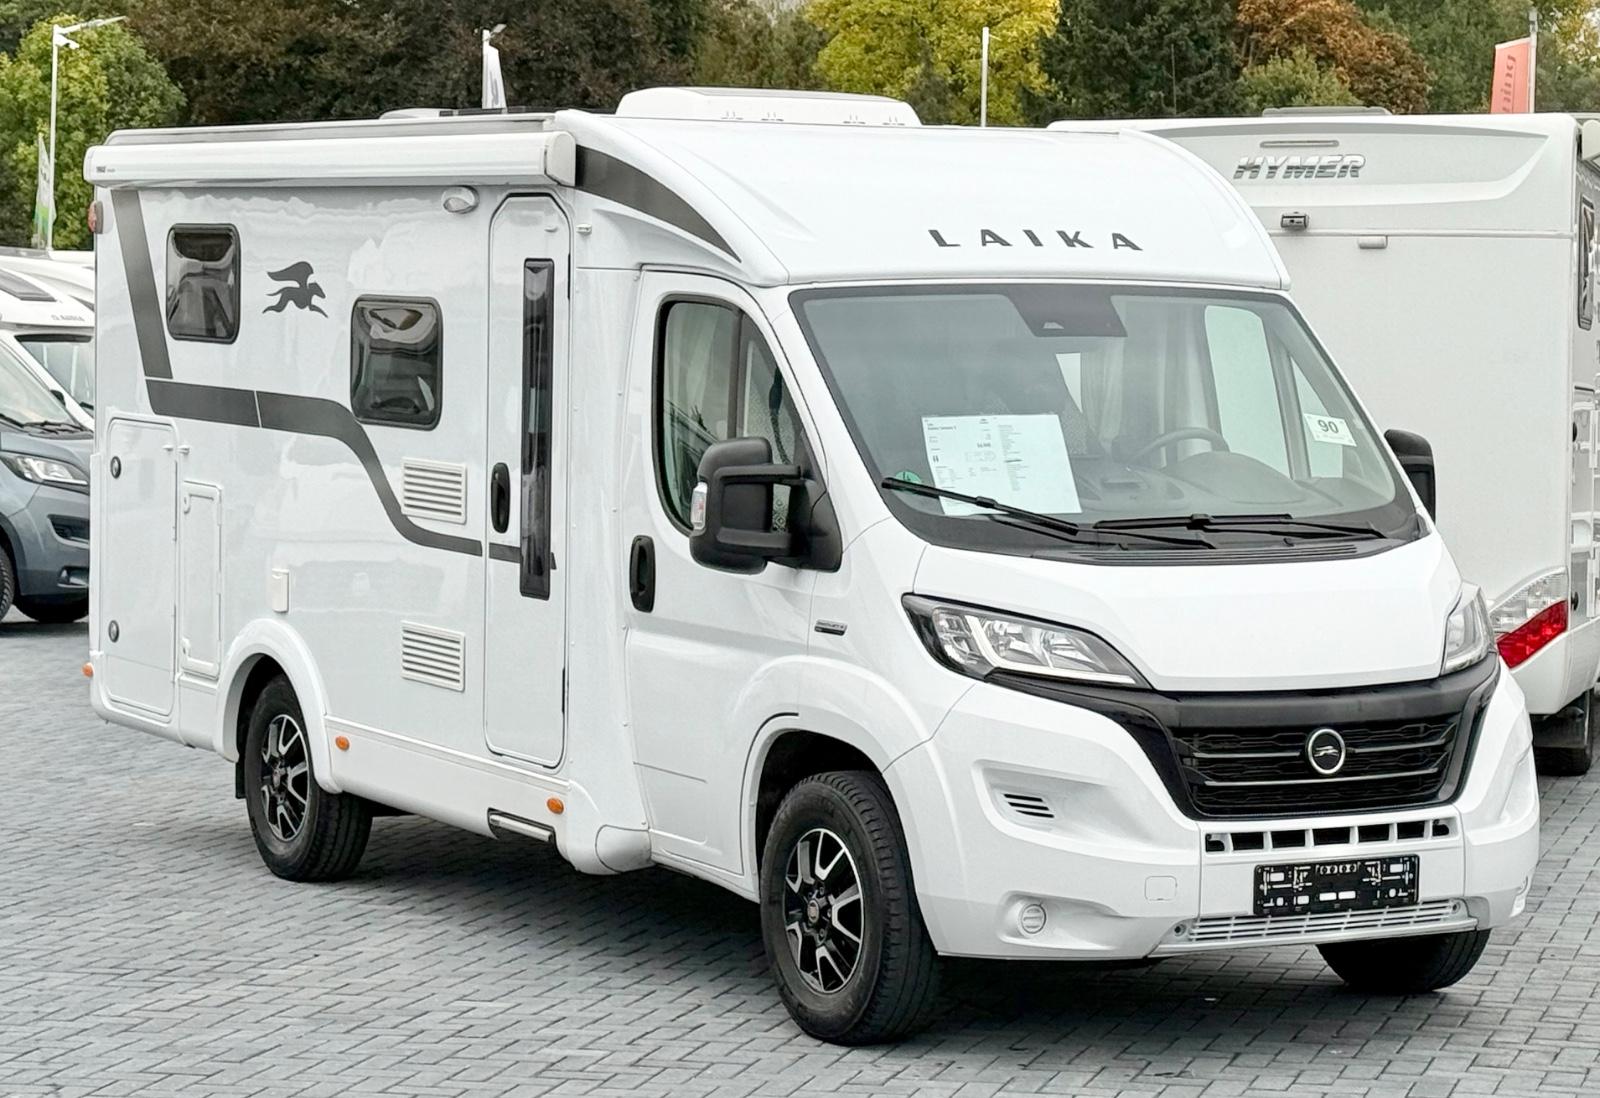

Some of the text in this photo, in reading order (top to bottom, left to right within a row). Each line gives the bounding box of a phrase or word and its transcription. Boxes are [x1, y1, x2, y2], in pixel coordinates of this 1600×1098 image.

[1233, 154, 1366, 179] HYMER
[928, 229, 1144, 251] LAIKA
[1317, 419, 1339, 434] 90
